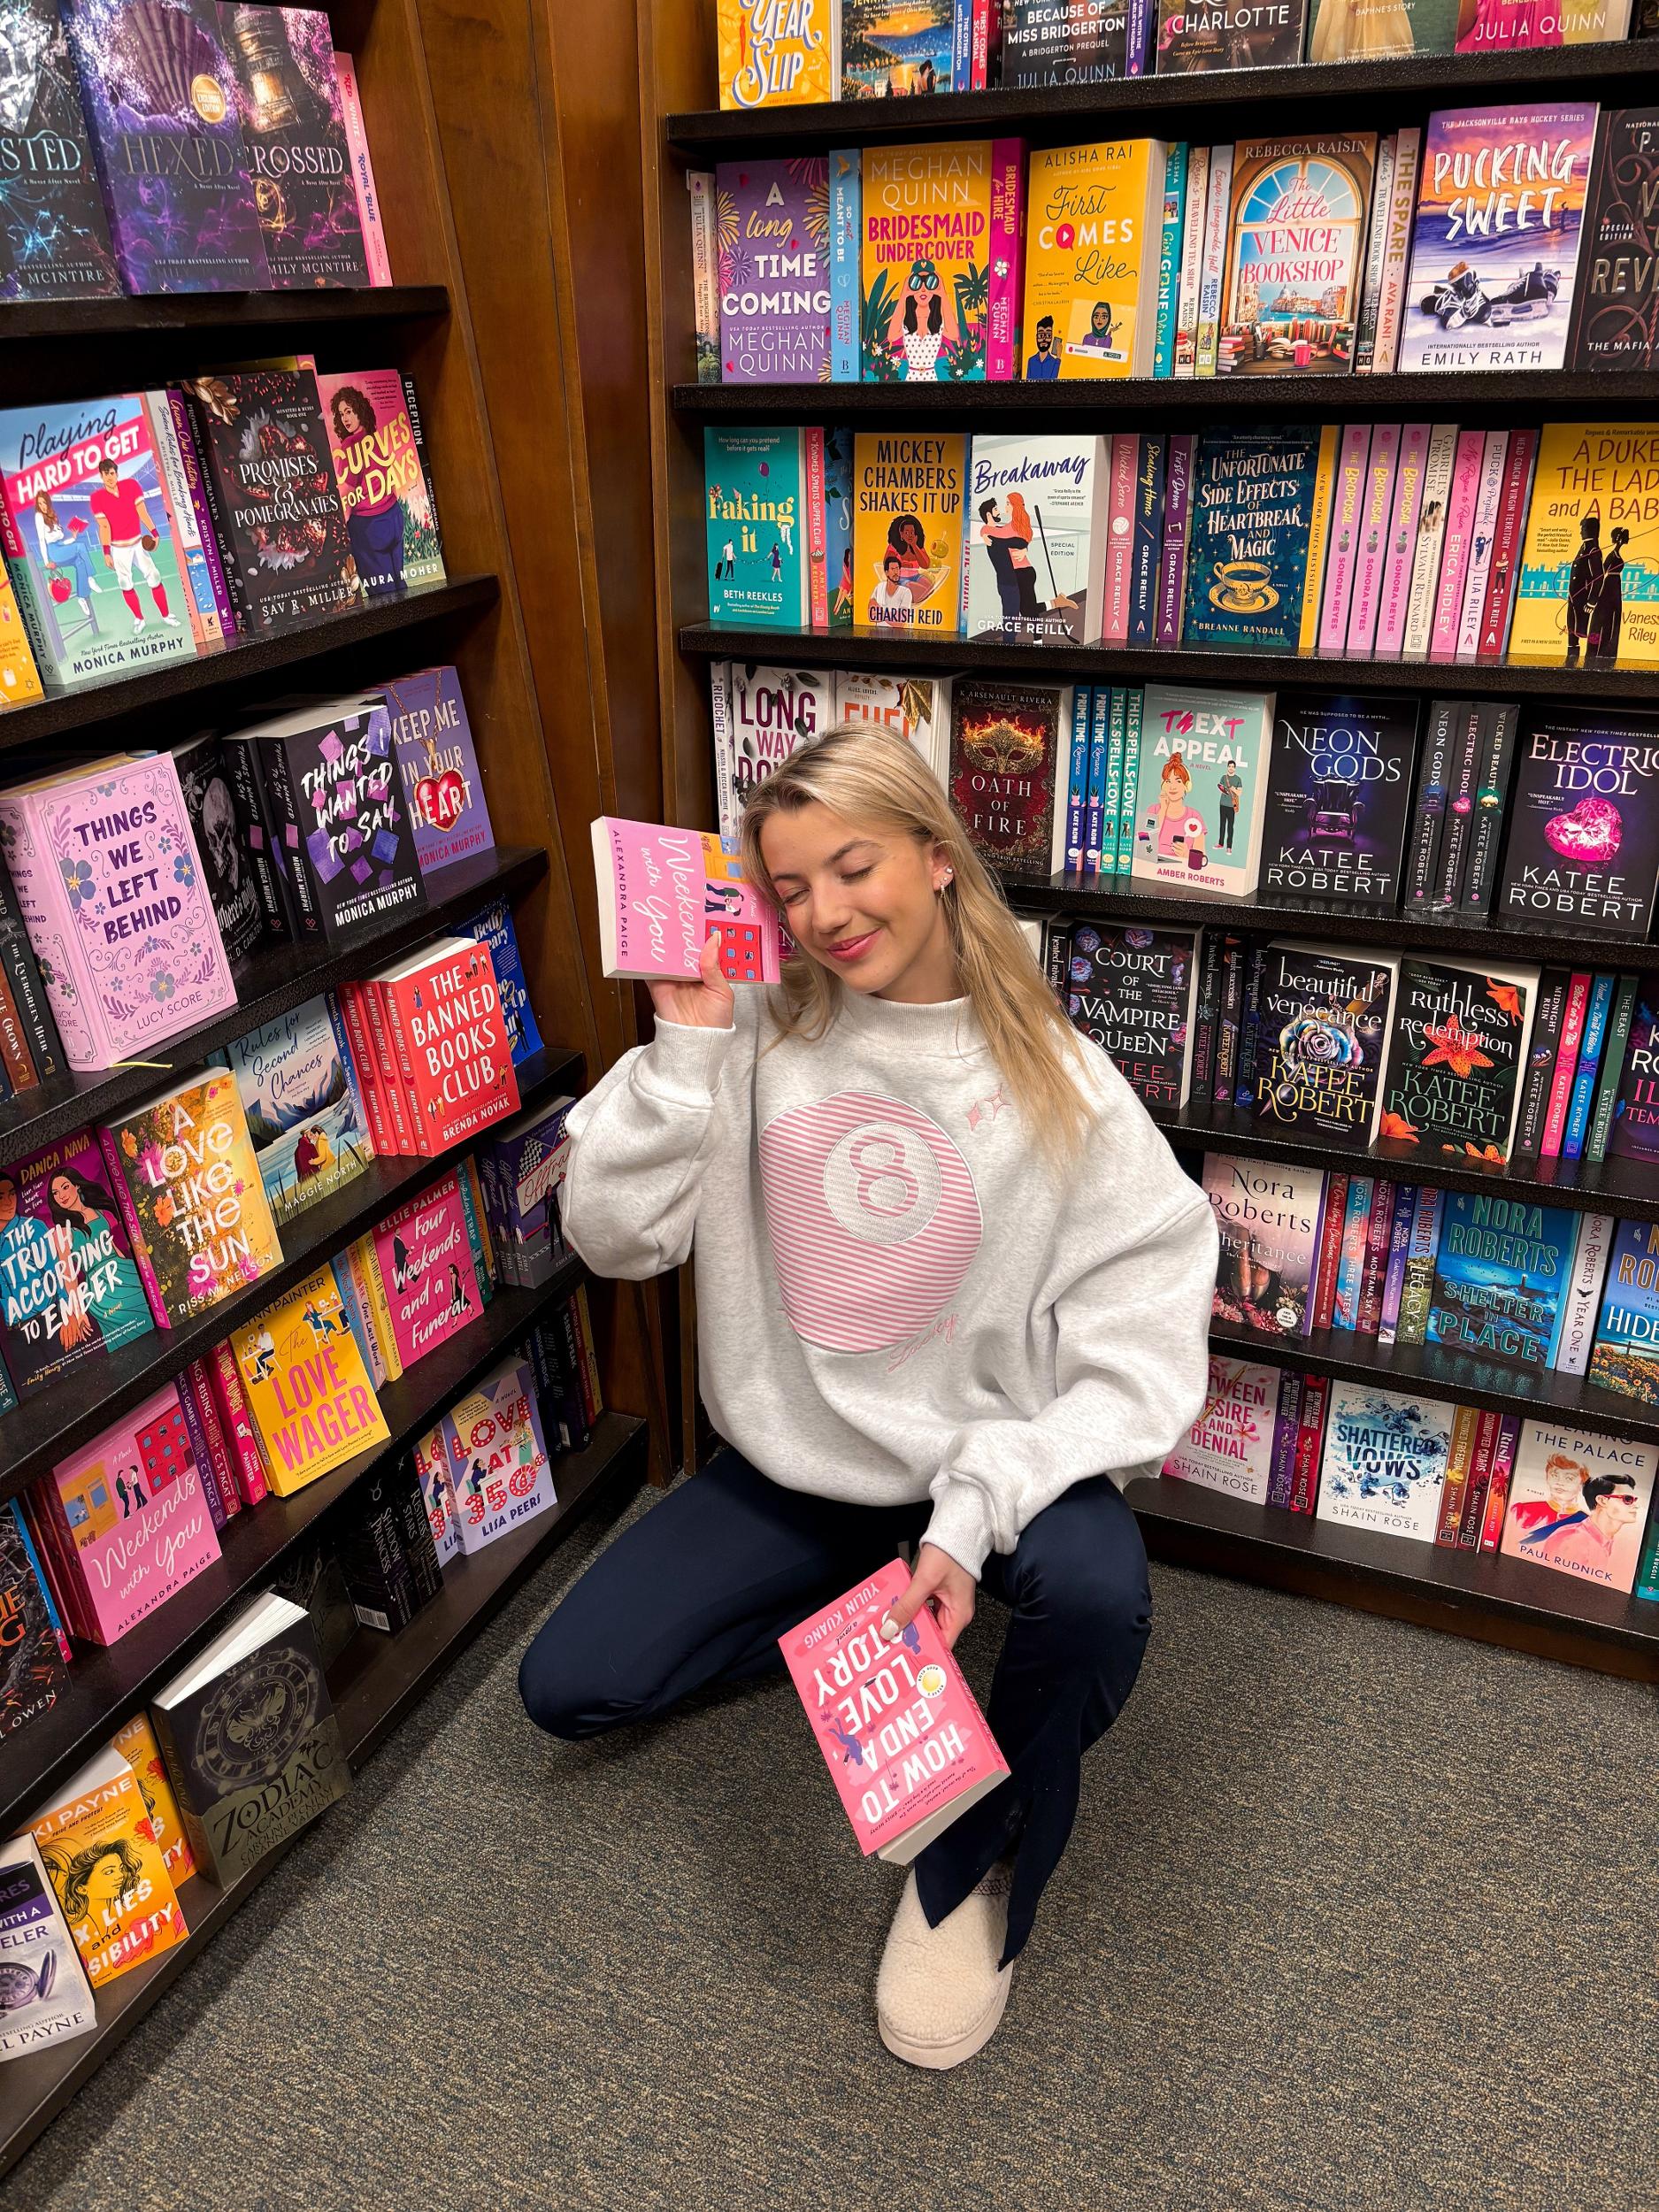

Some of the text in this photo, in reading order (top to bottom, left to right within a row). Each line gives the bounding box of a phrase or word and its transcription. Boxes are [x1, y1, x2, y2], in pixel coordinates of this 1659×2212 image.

[1171, 4, 1290, 35] CHARLOTTE
[1356, 2, 1417, 17] DAPHNE'S STORY
[1474, 12, 1606, 42] JULIA QUINN
[1008, 16, 1125, 45] MISS BRIDGERTON
[122, 134, 235, 183] HEXED
[1246, 140, 1368, 158] REBECCA RAISIN
[1432, 138, 1580, 195] PUCKING
[357, 152, 376, 223] ROYAL BLUE
[1005, 165, 1017, 234] BRIDESMAID
[1046, 184, 1117, 221] First
[1266, 184, 1332, 223] Little
[746, 211, 794, 247] long
[868, 211, 985, 242] BRIDESMAID
[1446, 186, 1565, 241] SWEET
[876, 240, 975, 264] UNDERCOVER
[1253, 228, 1341, 256] VENICE
[27, 269, 104, 285] MCINTIRE
[754, 253, 817, 279] TIME
[1073, 249, 1137, 285] Like
[1243, 259, 1344, 284] BOOKSHOP
[722, 290, 832, 316] COMING
[1202, 284, 1210, 313] RAISIN
[1208, 278, 1218, 319] REBECCA
[729, 333, 825, 352] MEGHAN
[1422, 350, 1543, 365] EMILY RATH
[739, 353, 813, 376] QUINN
[404, 380, 424, 446] DECEPTION
[17, 405, 119, 471] Playing
[331, 411, 411, 486] CURVES
[876, 440, 946, 465] MICKEY
[238, 454, 319, 488] PROMISES
[341, 448, 419, 513] FOR DAYS
[864, 467, 957, 489] CHAMBERS
[974, 454, 1091, 494] Breakaway
[1210, 452, 1306, 481] UNFORTUNATE
[233, 494, 340, 530] POMEGRANATES
[709, 493, 795, 529] Faking
[859, 491, 961, 514] SHAKES IT UP
[1201, 480, 1297, 509] SIDE EFFECTS
[1207, 508, 1304, 536] HEARTBREAK
[1229, 535, 1276, 561] MAGIC
[400, 563, 440, 581] MOHER
[1438, 534, 1461, 634] ERICA RIDLEY
[724, 589, 783, 603] BETH REEKLES
[977, 618, 1075, 636] GRACE REILLY
[740, 687, 818, 733] LONG
[1153, 736, 1249, 768] APPEAL
[1278, 719, 1382, 757] NEON
[972, 775, 1032, 798] OATH
[1310, 754, 1402, 782] GODS
[1554, 764, 1638, 795] IDOL
[316, 761, 394, 830] WANTED
[408, 779, 474, 830] HEART
[990, 799, 1010, 812] OF
[73, 800, 158, 848] THINGS
[973, 813, 1028, 837] FIRE
[107, 840, 144, 871] WE
[612, 830, 627, 910] ALEXANDRA
[1279, 846, 1374, 871] KATEE
[106, 867, 159, 910] LEFT
[1267, 868, 1392, 895] ROBERT
[1523, 865, 1626, 895] KATEE
[103, 895, 182, 946] BEHIND
[334, 882, 419, 927] MONICA MURPHY
[632, 847, 671, 963] with You
[657, 835, 702, 972] Weekends
[1509, 887, 1644, 921] ROBERT
[429, 964, 463, 1002] THE
[1094, 947, 1174, 978] COURT
[1279, 956, 1375, 1002] beautiful
[135, 989, 204, 1031] LUCY SCORE
[410, 981, 495, 1048] BANNED
[1079, 995, 1181, 1032] VAMPIRE
[1267, 995, 1382, 1033] vengeance
[426, 1018, 496, 1078] BOOKS
[1087, 1028, 1169, 1056] QUEEN
[442, 1054, 495, 1104] CLUB
[1270, 1056, 1366, 1100] KATEE
[1403, 1069, 1497, 1113] KATEE
[1258, 1078, 1375, 1124] ROBERT
[1389, 1089, 1505, 1136] ROBERT
[1550, 1075, 1566, 1134] KATEE ROBERT
[20, 1133, 92, 1184] DANICA NAVA
[144, 1121, 234, 1189] LOVE
[849, 1133, 919, 1217] 8
[165, 1158, 234, 1219] LIKE
[283, 1159, 358, 1213] MAGGIE NORTH
[1221, 1163, 1294, 1200] Nora
[4, 1216, 37, 1248] THE
[174, 1195, 242, 1249] THE
[1209, 1192, 1311, 1233] Roberts
[1471, 1194, 1543, 1240] NORA
[0, 1218, 75, 1290] TRUTH
[188, 1227, 251, 1284] SUN
[391, 1221, 462, 1291] Weekends
[1448, 1223, 1559, 1277] ROBERTS
[7, 1228, 114, 1326] ACCORDING
[20, 1258, 125, 1345] TO EMBER
[411, 1284, 469, 1349] Funeral
[1443, 1280, 1544, 1324] SHELTER
[1437, 1311, 1541, 1363] PLACE
[272, 1345, 347, 1420] LOVE
[272, 1386, 379, 1472] WAGER
[452, 1394, 534, 1463] LOVE
[1191, 1427, 1248, 1462] DENIAL
[1535, 1430, 1646, 1467] THE PALACE
[1173, 1459, 1259, 1496] SHAIN ROSE
[1346, 1443, 1422, 1481] VOWS
[89, 1471, 196, 1590] Weekends
[481, 1494, 542, 1538] LISA PEERS
[1519, 1545, 1613, 1582] PAUL RUDNICK
[117, 1552, 212, 1632] ALEXANDRA PAIGE
[803, 1582, 879, 1648] YULIN KUANG
[11, 1688, 57, 1729] OWEN
[837, 1655, 917, 1735] LOVE
[860, 1697, 935, 1771] END A
[902, 1723, 966, 1793] HOW
[63, 1778, 134, 1827] PAYNE
[211, 1741, 334, 1858] ZODIAC
[861, 1788, 900, 1824] TO
